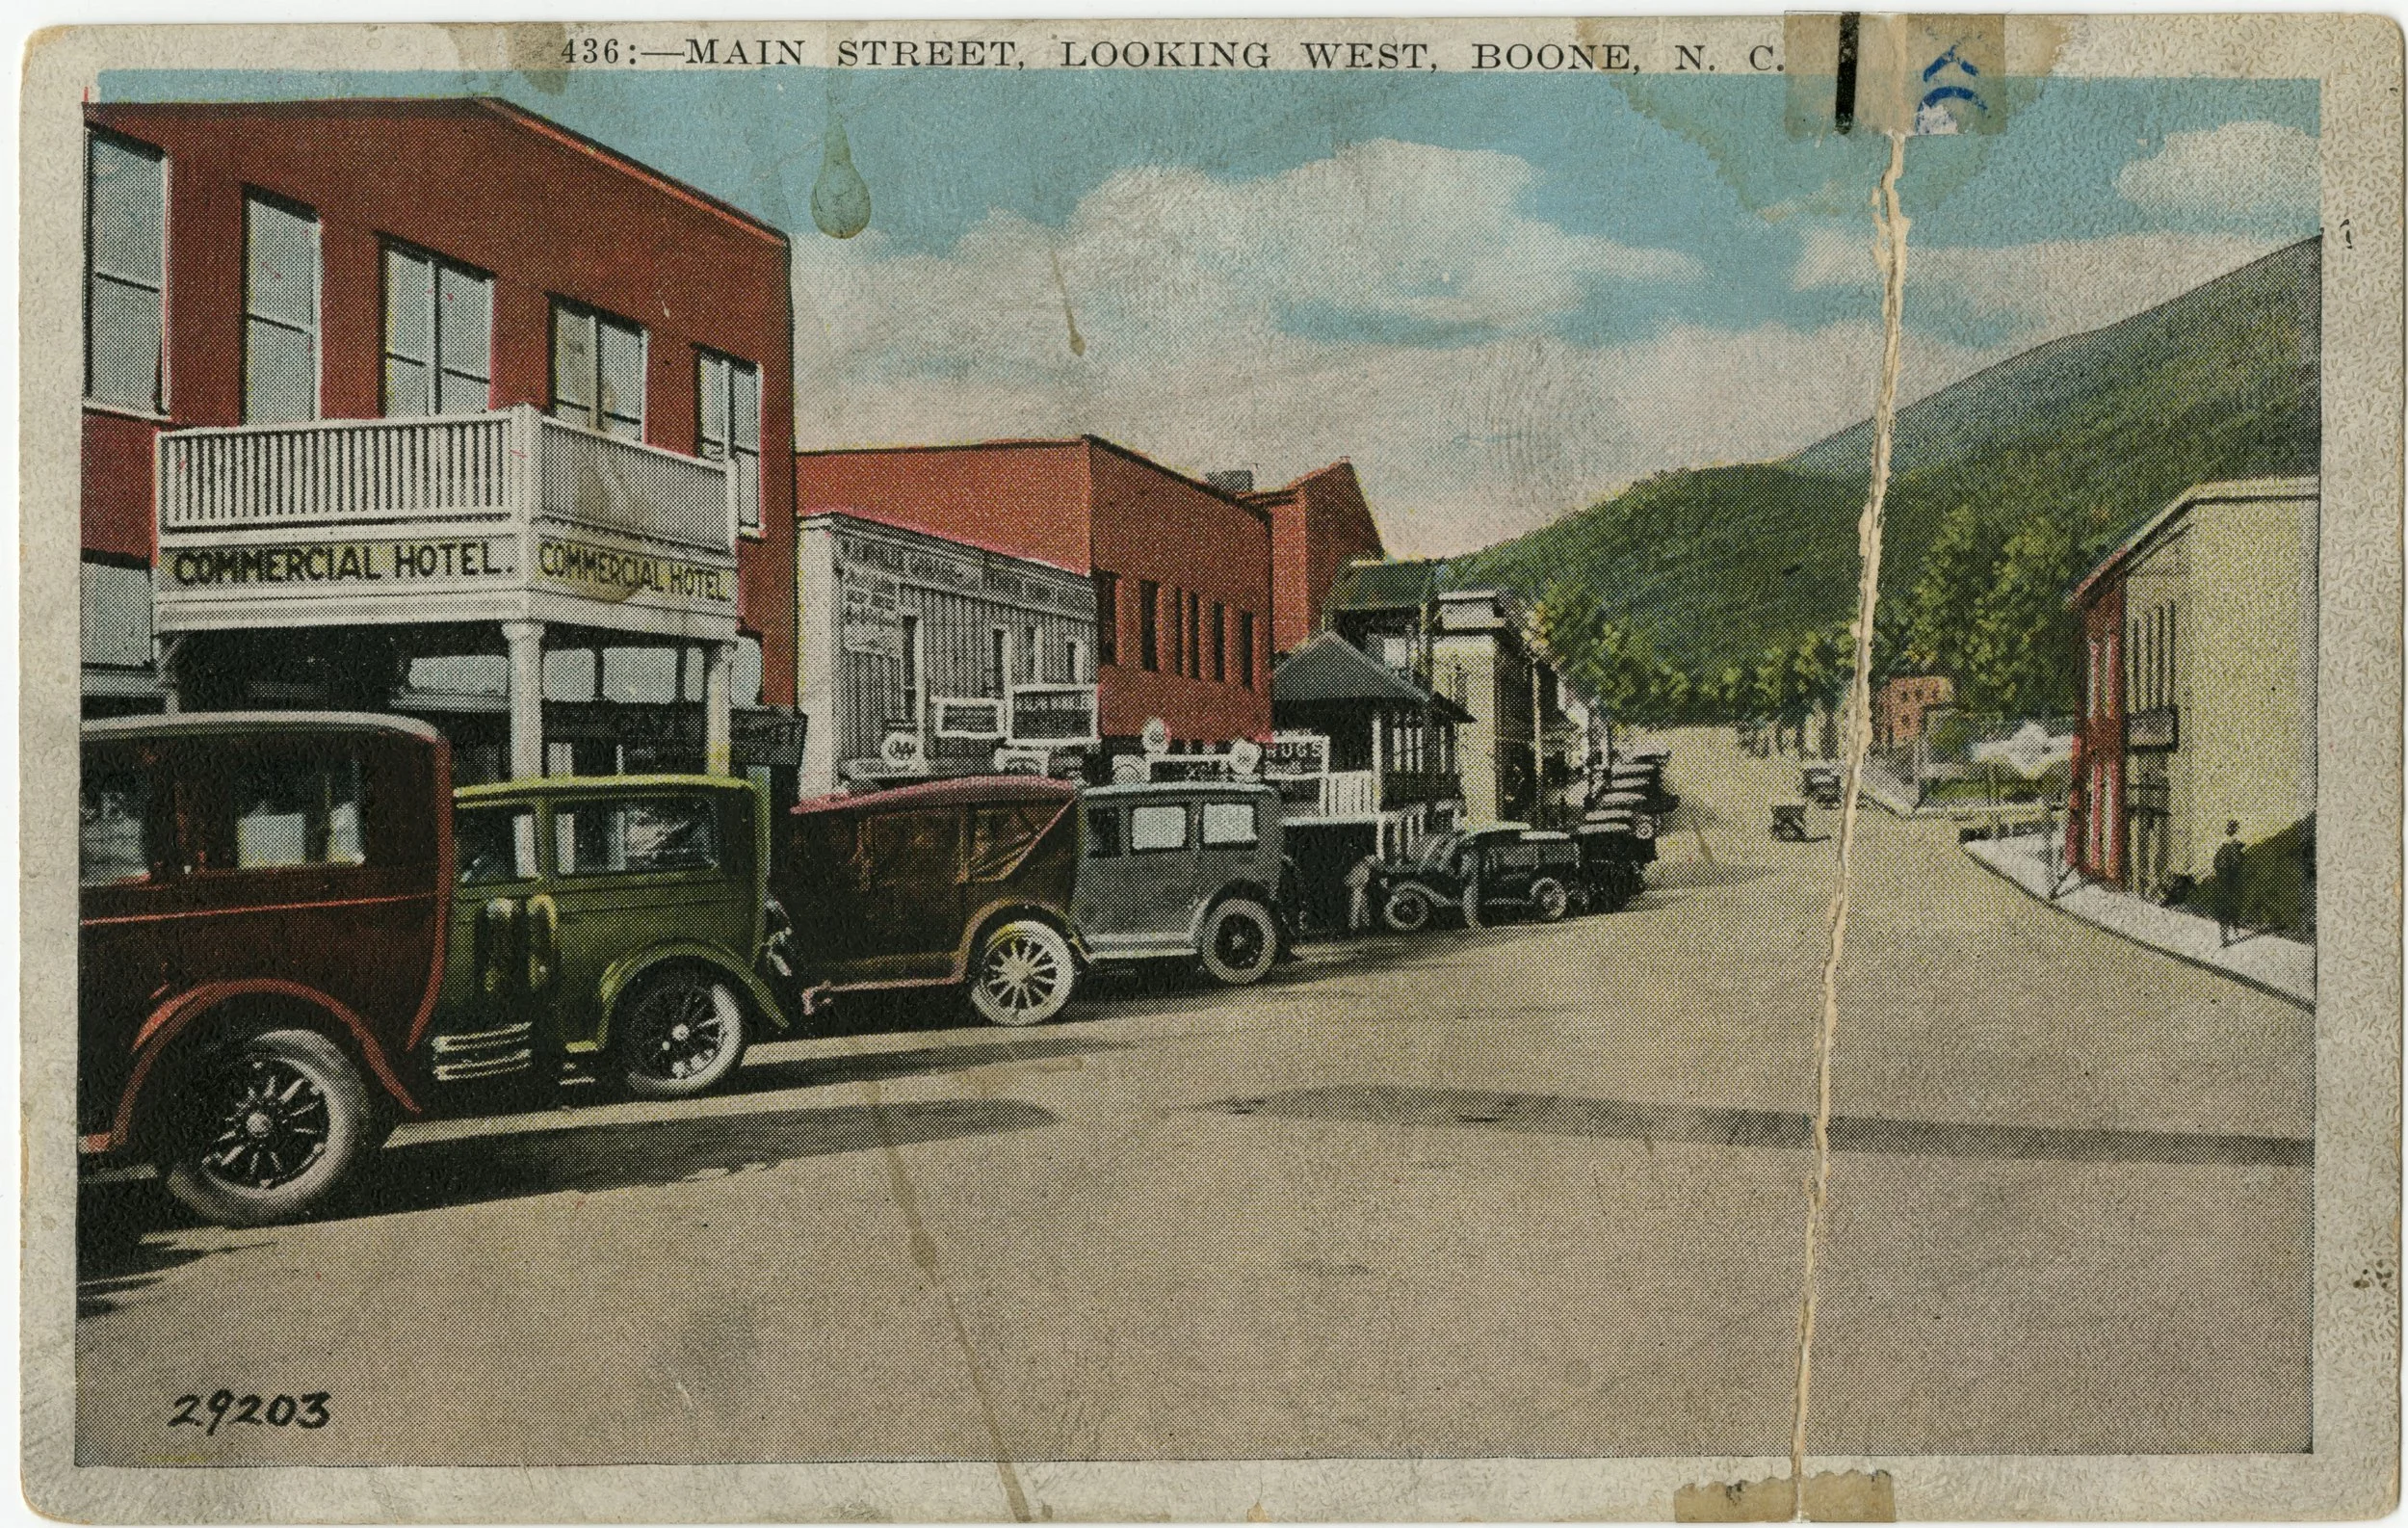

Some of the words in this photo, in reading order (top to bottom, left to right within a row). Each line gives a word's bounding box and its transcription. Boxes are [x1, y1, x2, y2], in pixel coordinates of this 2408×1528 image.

[174, 543, 383, 586] COMMERCIAL
[393, 540, 515, 578] HOTEL.
[539, 541, 666, 593] COMMERCIAL
[669, 562, 732, 602] HOTEL
[168, 1388, 332, 1436] 29203
